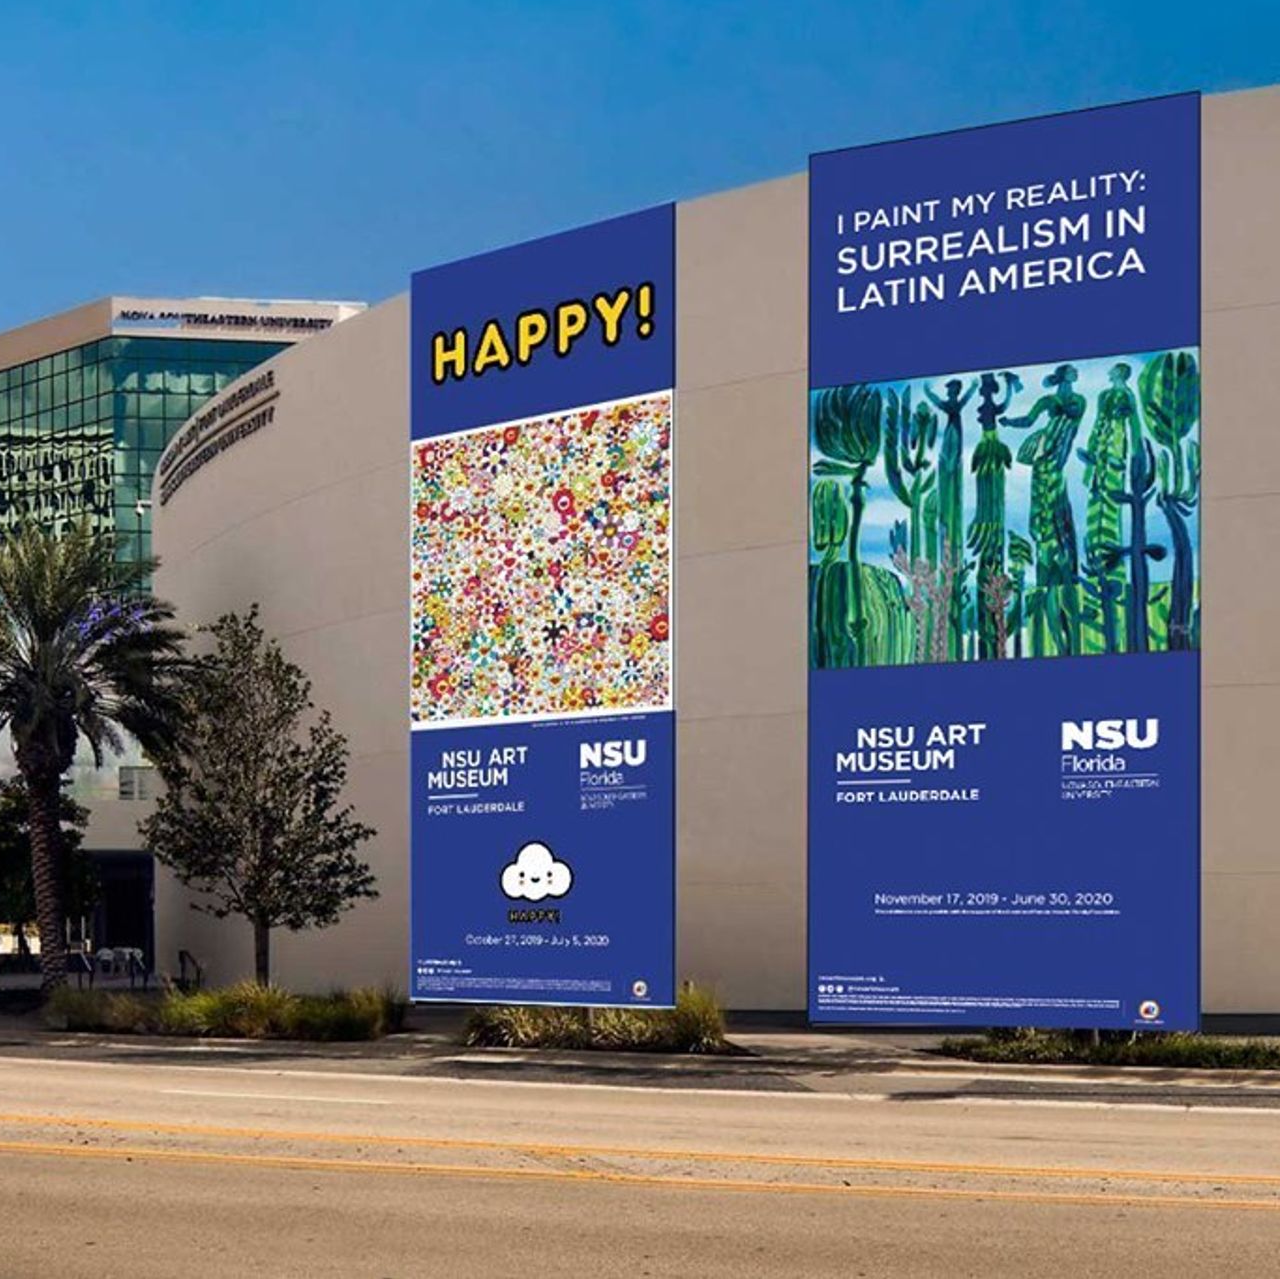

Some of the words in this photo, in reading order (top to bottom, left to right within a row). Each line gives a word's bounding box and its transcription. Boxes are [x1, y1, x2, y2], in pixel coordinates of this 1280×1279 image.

[837, 214, 844, 235] I
[854, 199, 940, 232] PAINT
[951, 191, 996, 218] MY
[1006, 170, 1147, 210] REALITY:
[837, 213, 1090, 275] SURREALISM
[1106, 204, 1147, 239] IN
[837, 273, 945, 314] LATIN
[959, 247, 1147, 297] AMERICA
[431, 280, 655, 385] HAPPY!
[858, 727, 914, 748] NSU
[926, 724, 986, 746] ART
[1062, 719, 1158, 750] NSU
[443, 750, 480, 768] NSU
[489, 747, 527, 765] ART
[580, 740, 646, 768] NSU
[837, 749, 954, 772] MUSEUM
[1062, 754, 1125, 772] Florida
[428, 768, 507, 788] MUSEUM
[579, 770, 623, 786] Florida
[837, 792, 874, 802] FORT
[879, 789, 978, 801] LAUDERDALE
[427, 803, 454, 815] FORT
[456, 801, 525, 815] LAUDERDALE
[874, 892, 944, 905] November
[946, 893, 965, 907] 17,
[966, 893, 999, 905] 2019
[1010, 893, 1046, 905] June
[1050, 893, 1072, 907] 30,
[1075, 892, 1114, 905] 2020
[465, 933, 503, 946] October
[584, 934, 610, 946] 2020
